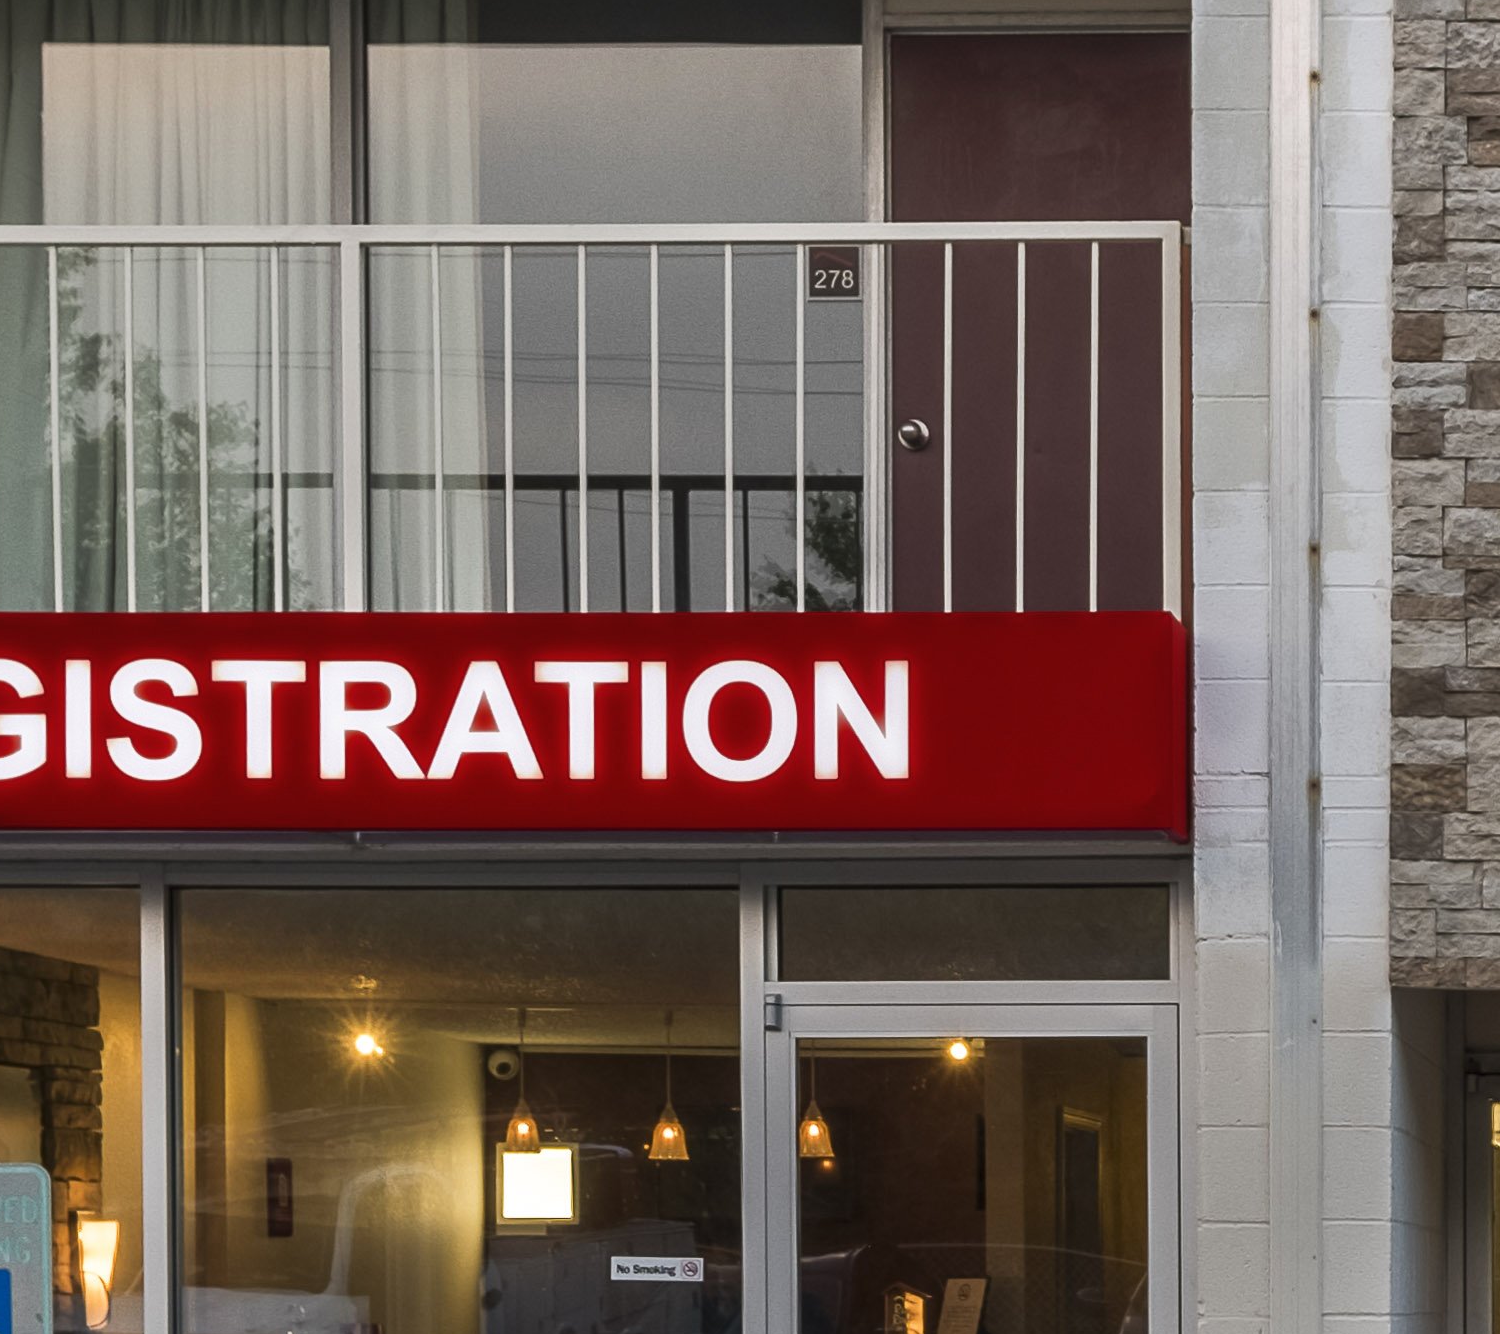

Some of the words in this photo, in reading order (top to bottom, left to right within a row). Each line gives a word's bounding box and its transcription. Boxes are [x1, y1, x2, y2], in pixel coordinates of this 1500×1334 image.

[814, 269, 854, 289] 278
[616, 1264, 631, 1274] No
[633, 1264, 677, 1277] Smoking
